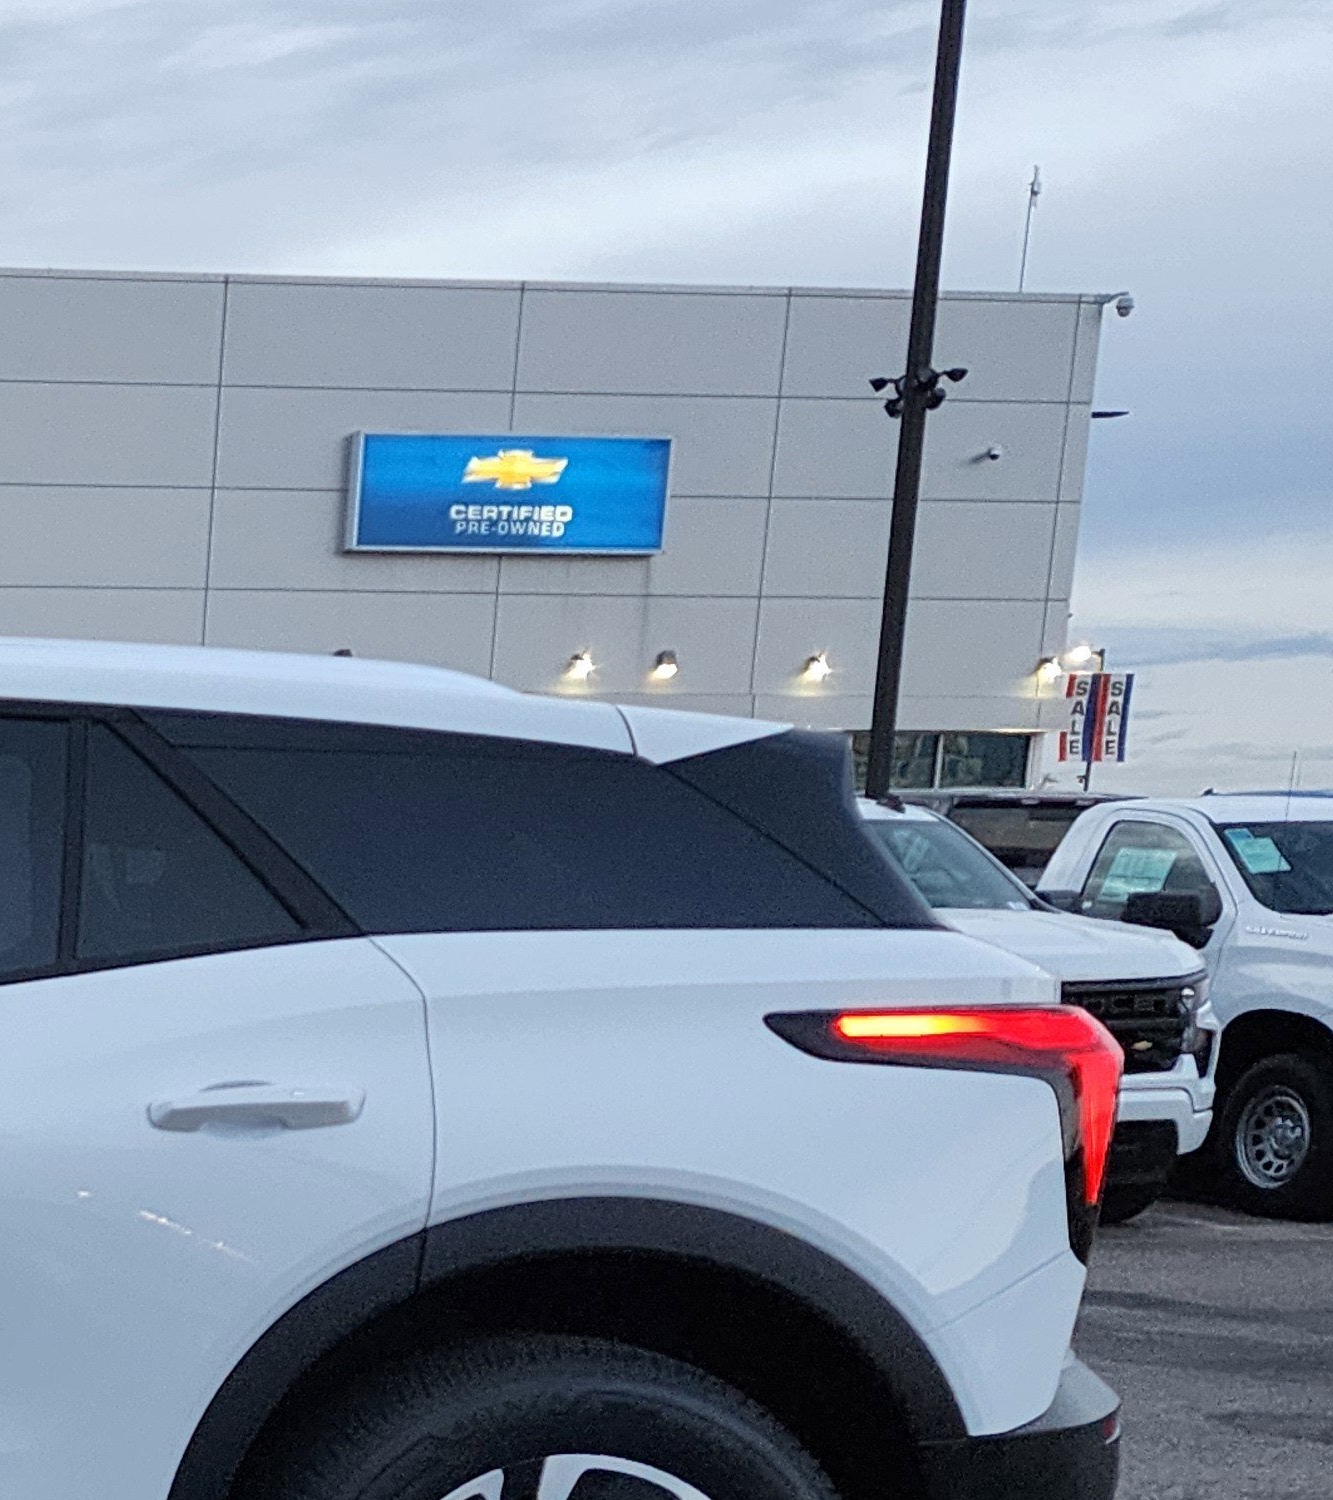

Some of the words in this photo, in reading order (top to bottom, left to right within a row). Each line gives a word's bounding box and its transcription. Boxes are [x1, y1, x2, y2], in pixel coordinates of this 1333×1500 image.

[449, 504, 573, 522] CERTIFIED
[455, 521, 565, 537] PRE-OWNED
[1069, 680, 1089, 755] SALE
[1105, 681, 1124, 755] SALE
